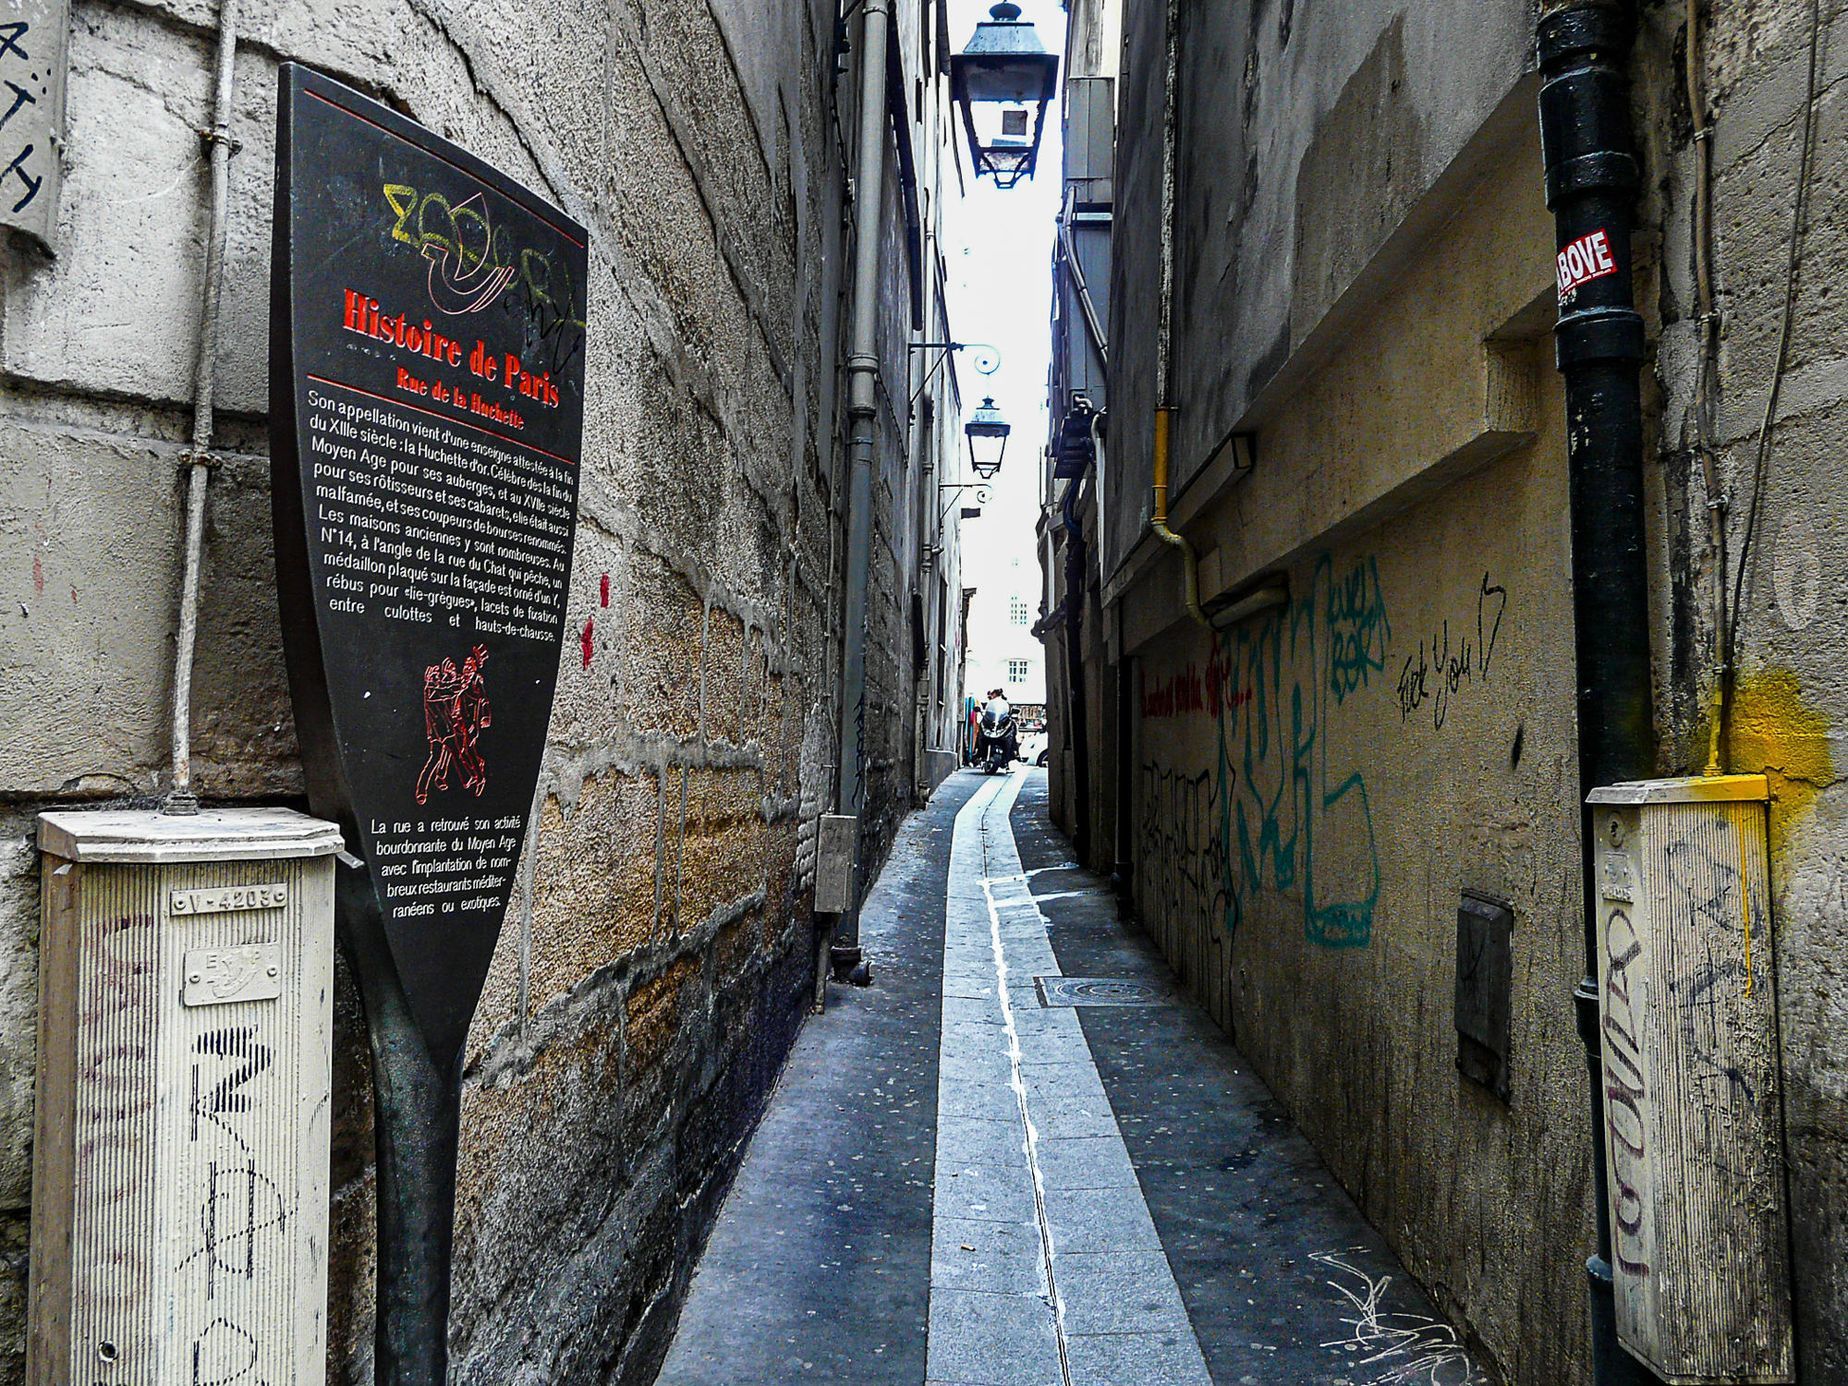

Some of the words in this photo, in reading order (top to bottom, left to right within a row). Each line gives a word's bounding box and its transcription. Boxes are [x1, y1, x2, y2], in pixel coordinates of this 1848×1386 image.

[343, 288, 462, 367] Histoire
[470, 339, 498, 382] de
[504, 352, 560, 408] Paris
[397, 366, 428, 396] Rue
[432, 379, 450, 403] de
[453, 386, 468, 409] la
[471, 392, 525, 431] Huchette
[308, 390, 335, 411] Son
[338, 401, 410, 433] appellation
[412, 422, 441, 441] vient
[441, 429, 469, 450] d'une
[471, 442, 512, 464] enseigne
[513, 454, 548, 477] attestée
[549, 466, 555, 479] à
[555, 468, 563, 482] la
[564, 471, 574, 485] fin
[309, 414, 326, 431] du
[329, 418, 358, 439] XIIIe
[418, 442, 468, 469] Huchette
[471, 458, 490, 477] d'or.
[490, 464, 526, 488] Célèbre
[527, 479, 542, 491] dès
[543, 482, 551, 496] la
[552, 484, 562, 499] fin
[563, 489, 573, 503] du
[312, 435, 356, 460] Moyen
[360, 449, 387, 470] Age
[391, 460, 419, 475] pour
[423, 468, 443, 482] ses
[446, 473, 496, 500] auberges,
[498, 487, 508, 500] et
[510, 493, 521, 505] au
[523, 494, 545, 512] XVIIe
[547, 503, 570, 520] siècle,
[313, 462, 347, 480] pour
[348, 470, 371, 486] ses
[373, 474, 433, 501] rôtisseurs
[435, 490, 447, 504] et
[448, 494, 466, 509] ses
[467, 500, 512, 524] cabarets,
[512, 511, 528, 526] elle
[529, 514, 547, 532] était
[548, 522, 569, 537] aussi
[316, 485, 385, 513] malfamée,
[386, 499, 399, 513] et
[400, 504, 420, 518] ses
[422, 508, 473, 530] coupeurs
[473, 518, 486, 533] de
[486, 521, 522, 544] bourses
[523, 535, 567, 555] renommés.
[319, 503, 344, 523] Les
[350, 514, 400, 535] maisons
[405, 525, 461, 547] anciennes
[464, 539, 471, 553] y
[474, 541, 495, 555] sont
[498, 546, 551, 569] nombreuses.
[553, 558, 565, 572] Au
[324, 552, 385, 574] médaillon
[388, 561, 428, 583] plaqué
[431, 571, 448, 585] sur
[450, 572, 460, 587] la
[463, 574, 496, 594] façade
[498, 584, 512, 597] est
[513, 588, 533, 601] orné
[534, 590, 551, 605] d'un
[361, 534, 369, 550] à
[374, 536, 412, 560] l'angle
[416, 546, 431, 561] de
[434, 548, 445, 564] la
[448, 555, 466, 568] rue
[469, 557, 481, 571] du
[484, 559, 506, 577] Chat
[508, 567, 521, 582] qui
[523, 570, 551, 589] pêche,
[552, 578, 562, 589] un
[327, 573, 364, 592] rébus
[370, 583, 399, 598] pour
[481, 597, 509, 616] lacets
[512, 604, 524, 618] de
[527, 606, 558, 625] fixation
[329, 597, 365, 614] entre
[384, 605, 432, 623] culottes
[449, 613, 460, 627] et
[475, 616, 555, 642] hauts-de-chausse.
[371, 819, 387, 834] La
[393, 822, 411, 834] rue
[417, 822, 425, 833] a
[430, 816, 470, 832] retrouvé
[474, 819, 490, 830] son
[494, 815, 521, 830] activité
[376, 838, 447, 856] bourdonnante
[451, 838, 463, 851] du
[468, 836, 495, 854] Moyen
[499, 835, 517, 852] Age
[381, 864, 407, 877] avec
[412, 858, 472, 878] l'implantation
[475, 856, 487, 869] de
[490, 857, 512, 869] nom-
[387, 883, 417, 898] breux
[418, 879, 471, 894] restaurants
[473, 874, 507, 889] méditer-
[392, 902, 435, 919] ranéens
[441, 901, 455, 913] ou
[461, 895, 501, 912] exotiques.
